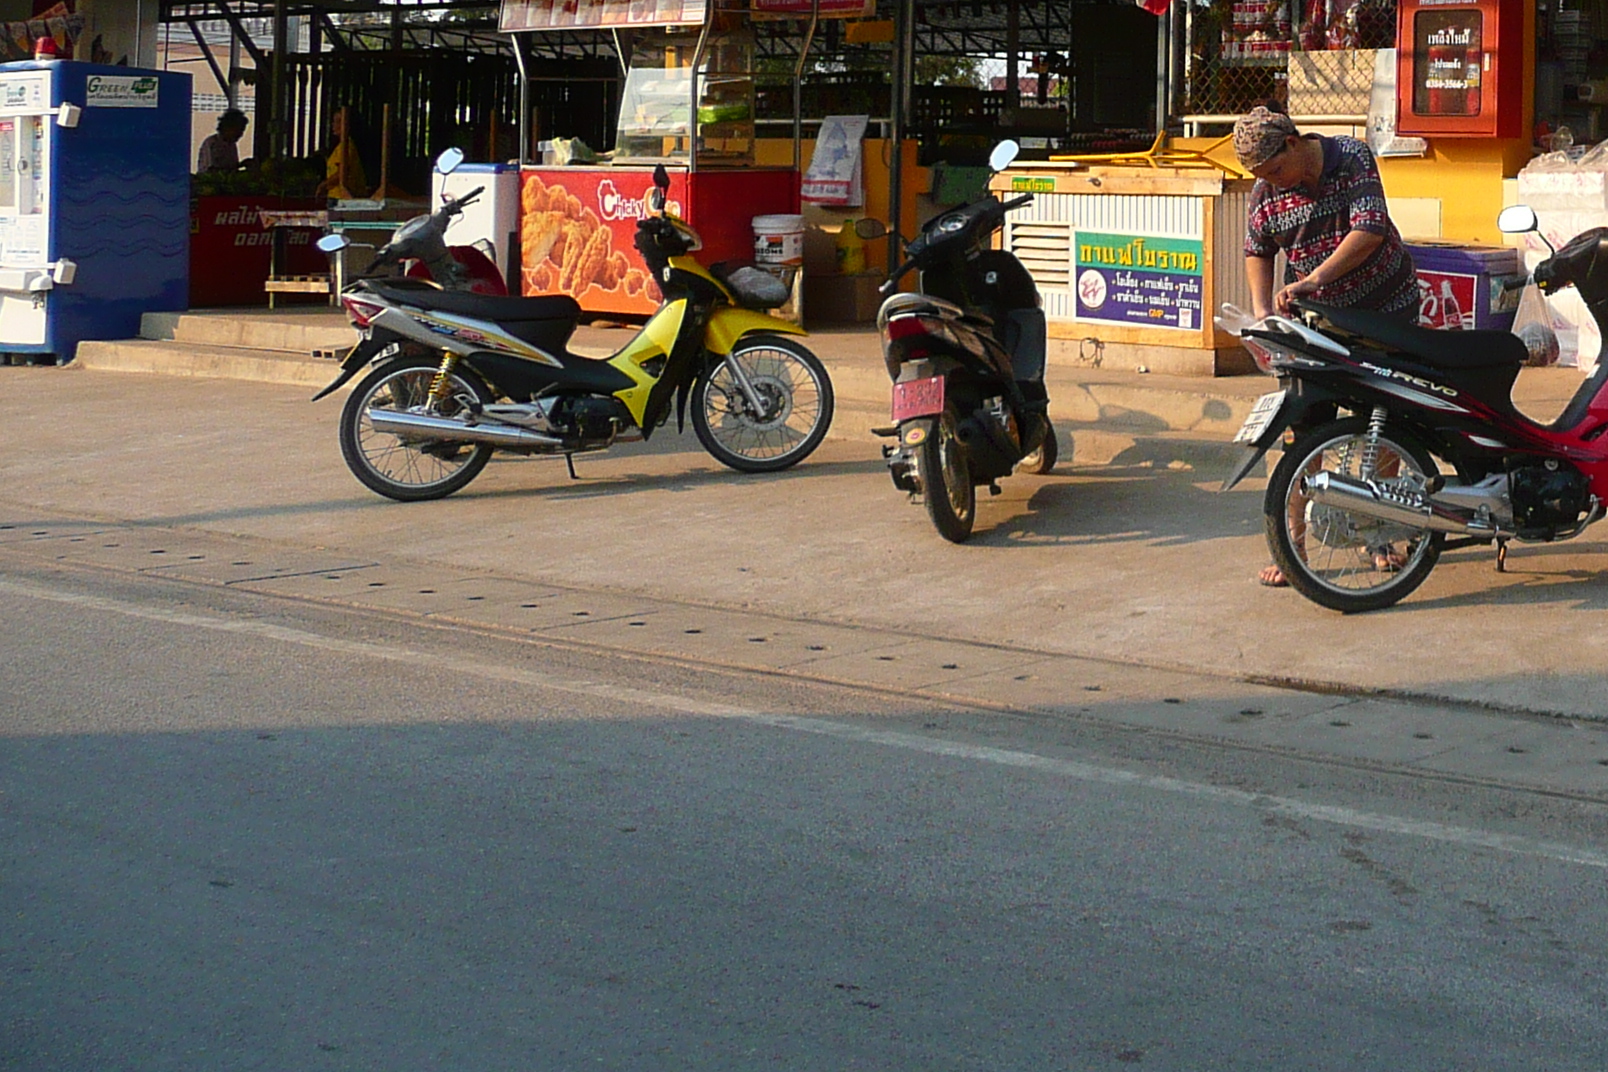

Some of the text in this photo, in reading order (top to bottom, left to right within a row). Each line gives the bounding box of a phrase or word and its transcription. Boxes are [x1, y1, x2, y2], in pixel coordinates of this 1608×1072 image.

[1428, 28, 1470, 45] เพลิงไหม้
[1079, 239, 1198, 272] กาแฟโบราณ
[1392, 371, 1458, 397] REVO
